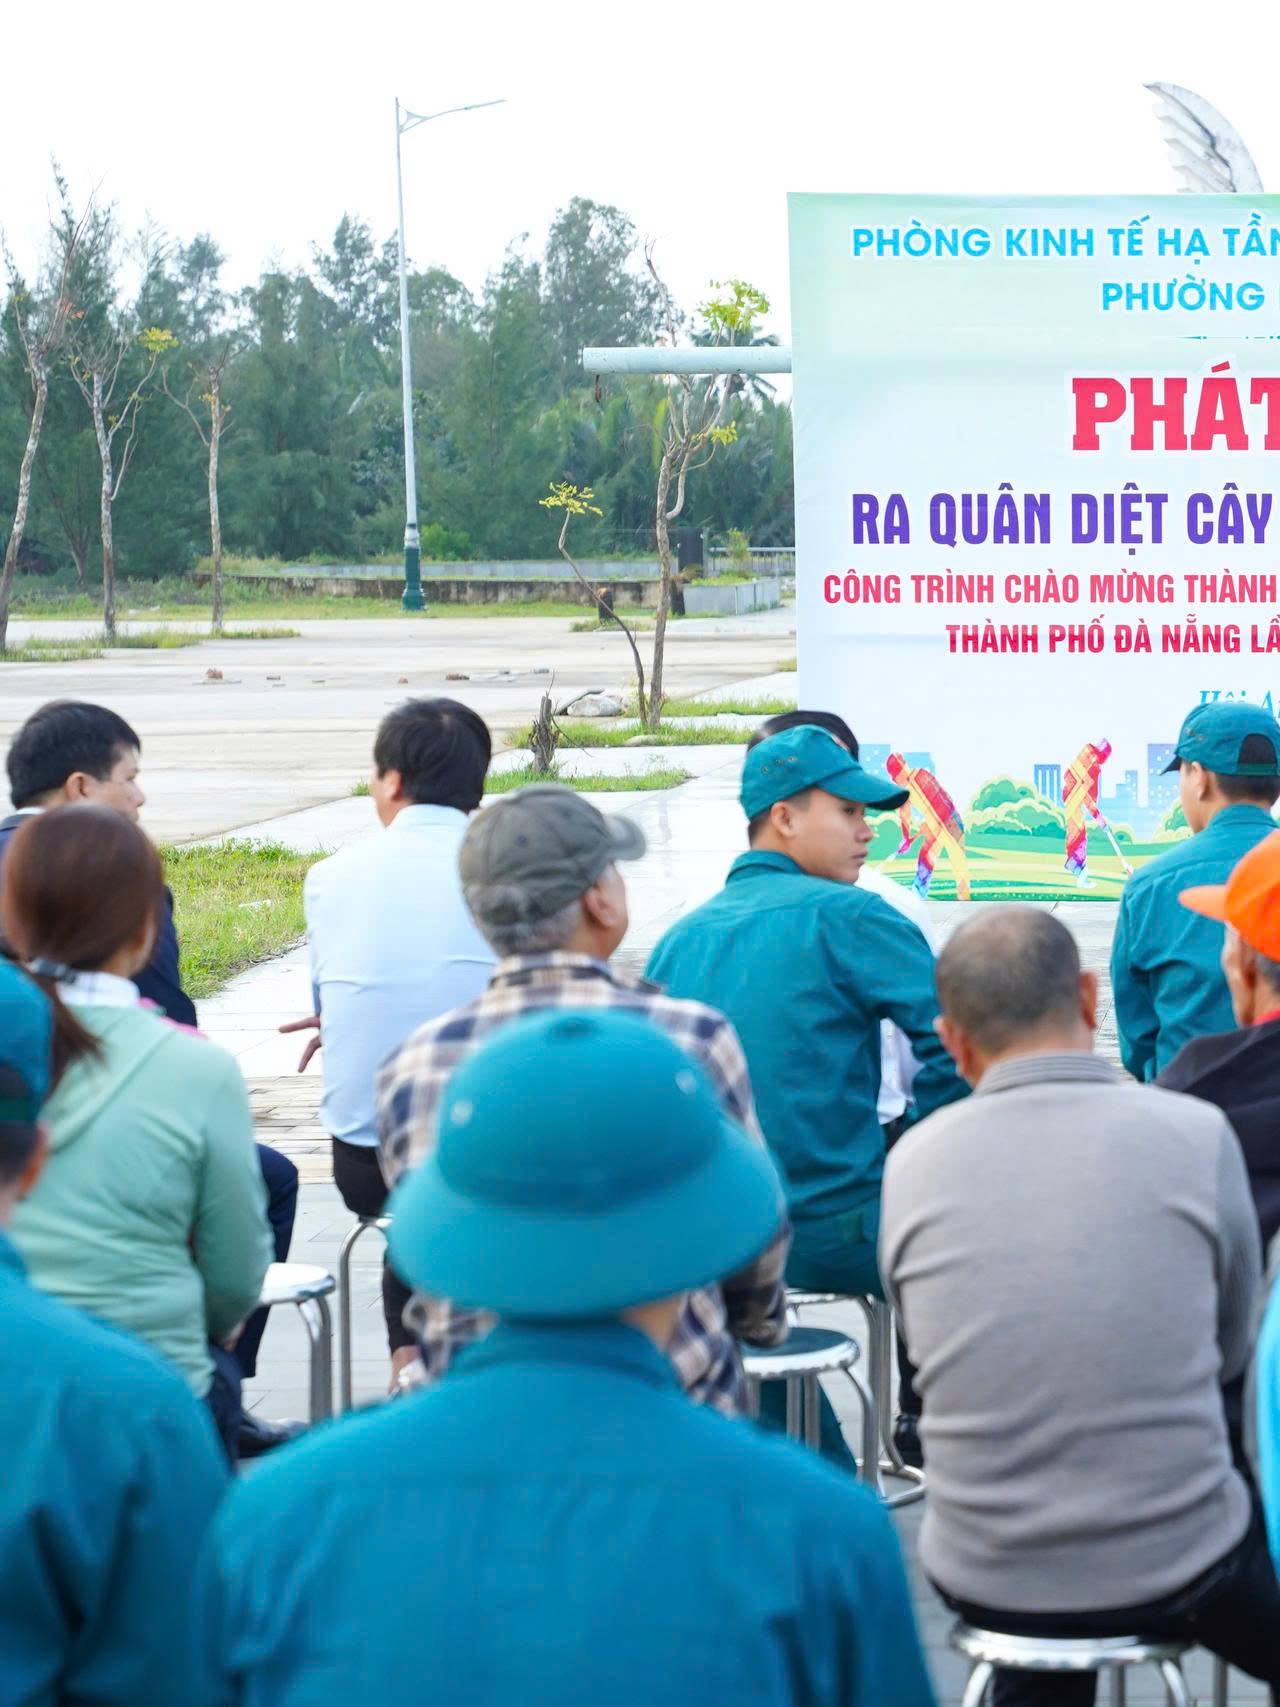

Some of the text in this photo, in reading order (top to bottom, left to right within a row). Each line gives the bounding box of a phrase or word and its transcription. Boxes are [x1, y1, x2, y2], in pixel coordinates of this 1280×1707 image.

[853, 219, 991, 257] PHÒNG
[1005, 228, 1094, 257] KINH
[1107, 214, 1150, 257] TẾ
[1158, 228, 1210, 265] HẠ
[1102, 274, 1265, 311] PHƯỜNG
[852, 493, 910, 545] RA
[929, 482, 1050, 548] QUÂN
[1071, 482, 1169, 556] DIỆT
[1187, 482, 1273, 545] CÂY
[823, 569, 901, 604] CÔNG
[911, 569, 995, 604] TRÌNH
[1004, 569, 1080, 604] CHÀO
[1089, 570, 1175, 604] MỪNG
[1184, 569, 1277, 604] THÀNH
[945, 619, 1039, 654] THÀNH
[1048, 615, 1106, 654] PHỐ
[1113, 619, 1153, 654] ĐÀ
[1161, 613, 1241, 654] NẴNG
